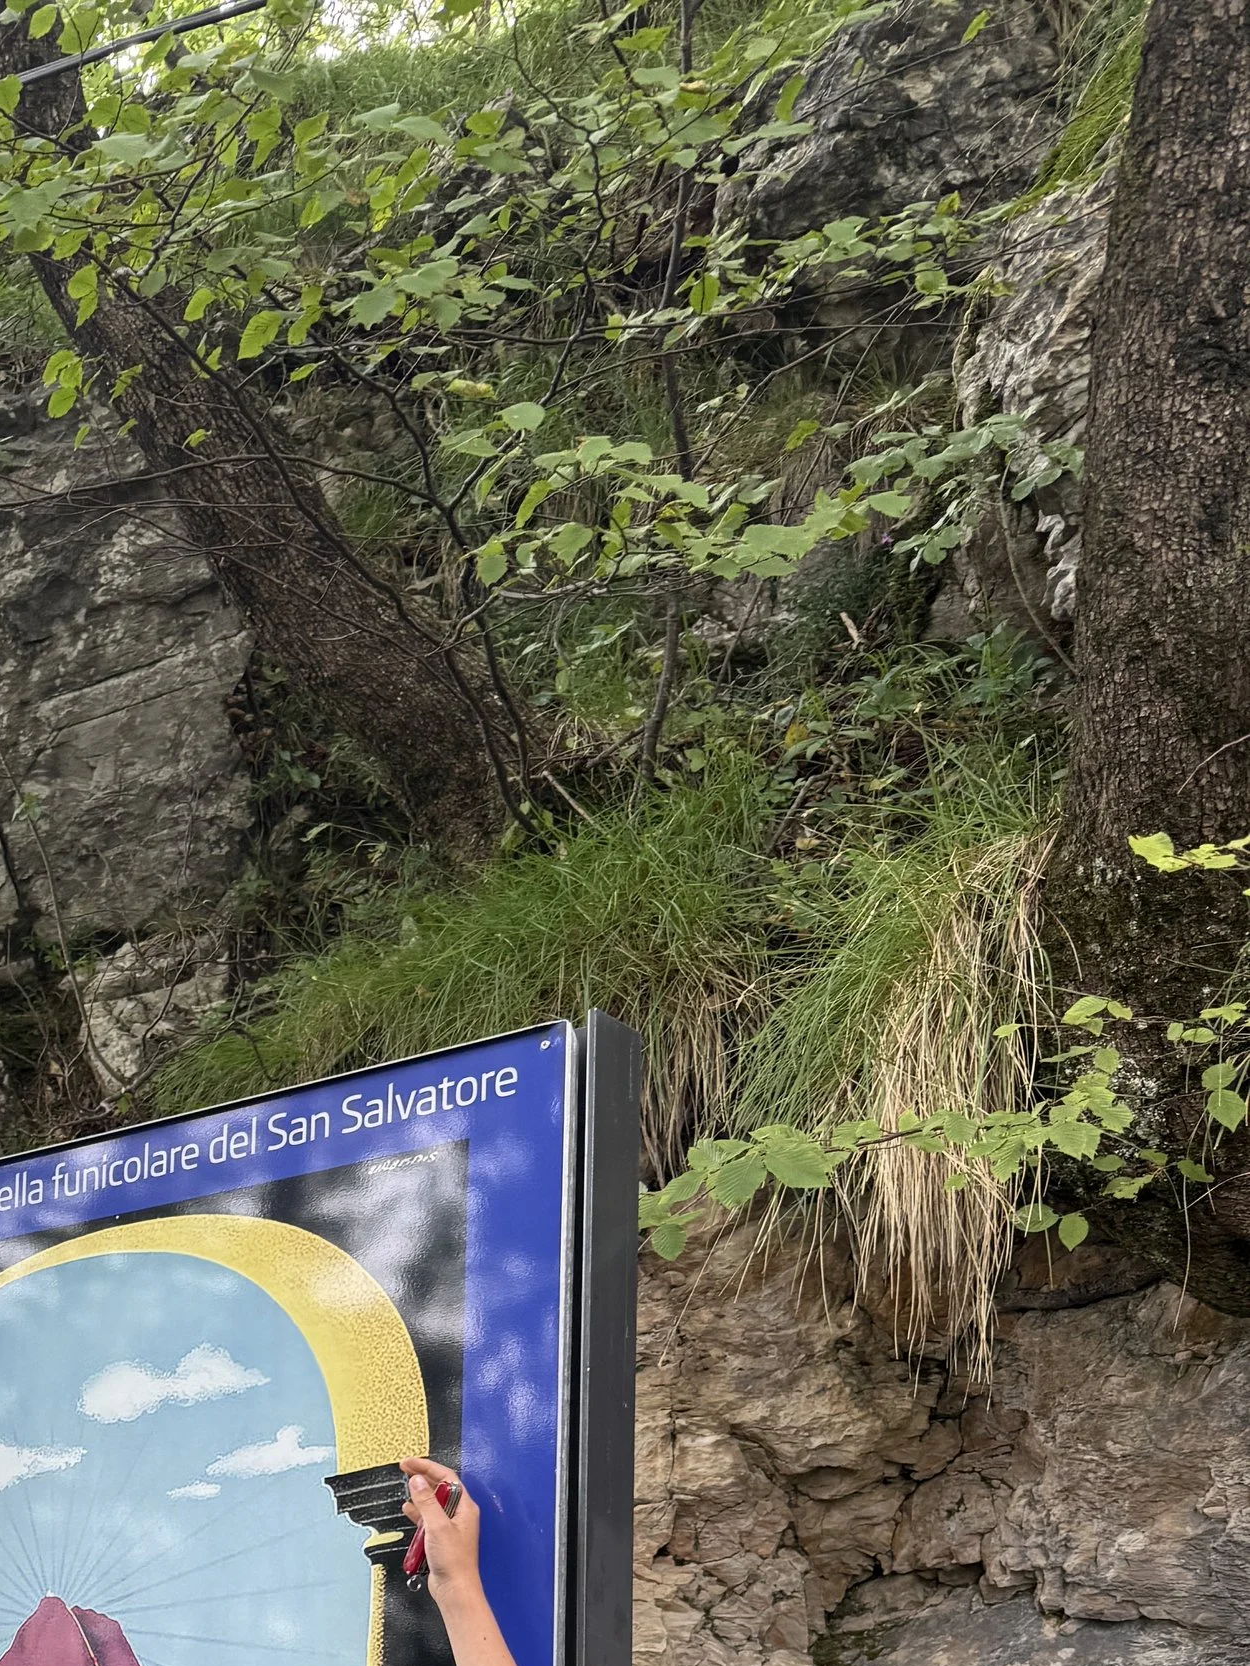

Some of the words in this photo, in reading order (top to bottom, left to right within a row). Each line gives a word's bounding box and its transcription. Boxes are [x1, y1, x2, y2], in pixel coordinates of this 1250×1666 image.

[50, 1143, 200, 1203] funicolare
[208, 1122, 258, 1163] del
[267, 1109, 332, 1153] San
[340, 1064, 518, 1135] Salvatore
